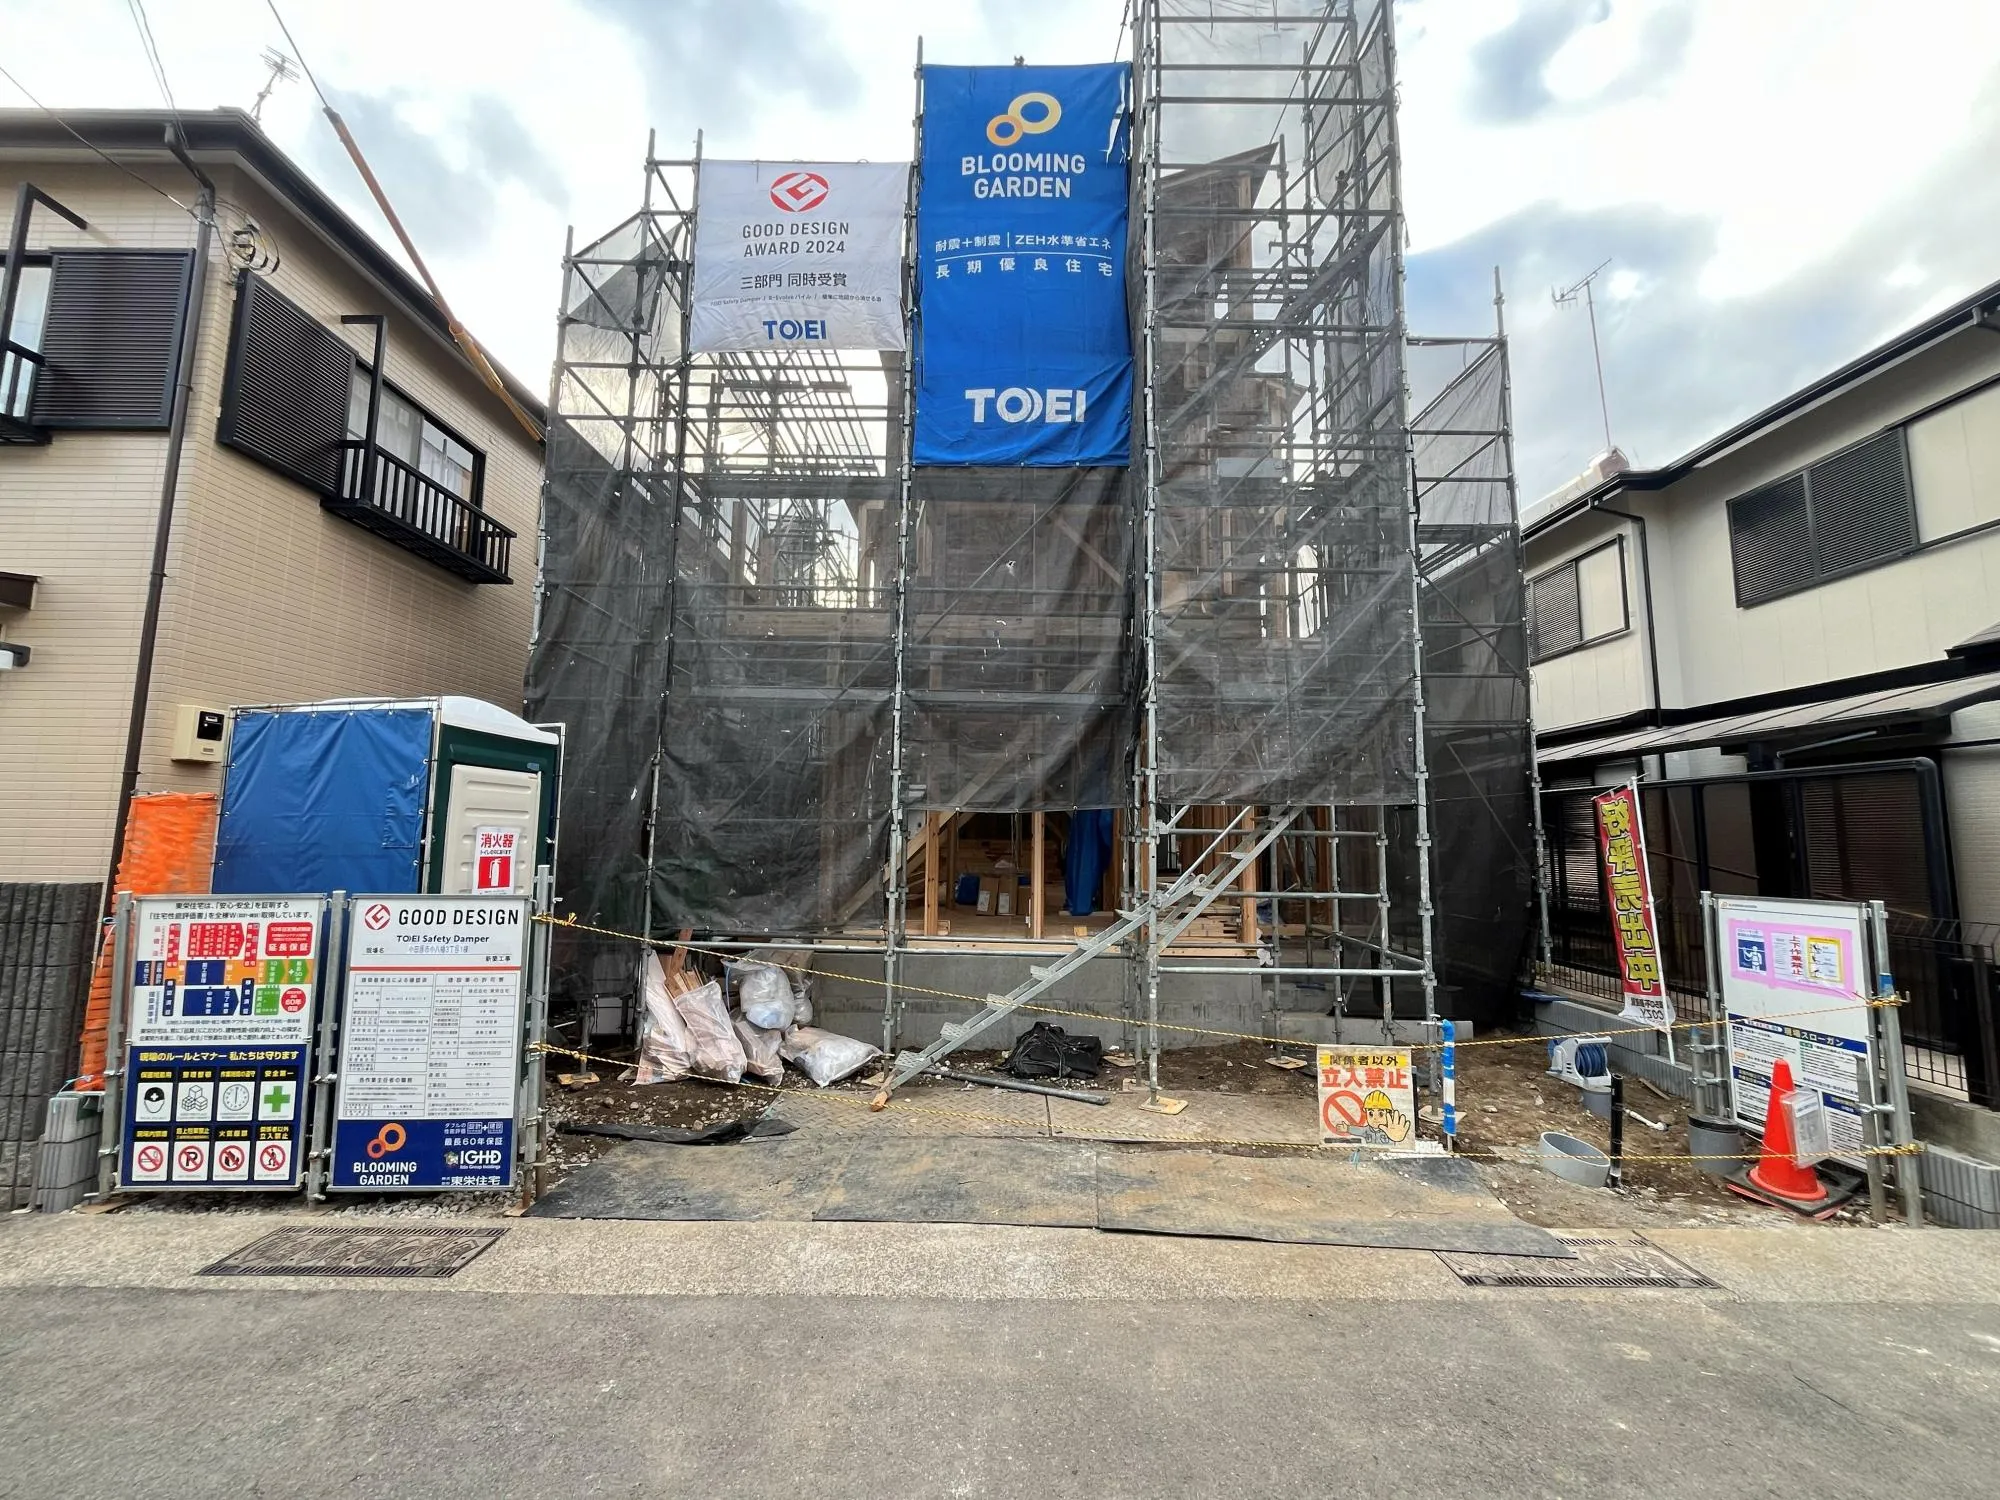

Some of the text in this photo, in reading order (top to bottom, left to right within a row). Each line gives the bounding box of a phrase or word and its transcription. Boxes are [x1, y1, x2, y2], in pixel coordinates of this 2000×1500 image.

[962, 153, 1086, 176] BLOOMING
[974, 176, 1071, 198] GARDEN
[742, 222, 849, 239] GOOD DESIGN
[744, 240, 846, 258] AWARD 2024
[1015, 234, 1112, 250] ZEH水準省エネ
[935, 257, 1113, 280] 長期優良住宅
[740, 272, 848, 290] 三部門 同時受賞
[480, 833, 514, 848] 消火器
[398, 909, 519, 925] GOOD DESIGN
[422, 935, 452, 944] Safety
[454, 935, 489, 944] Damper
[140, 1051, 299, 1062] 現場のルールとマナー 私たちは守ります
[1329, 1055, 1399, 1066] 関係者以外
[1321, 1067, 1408, 1089] 立入禁止
[353, 1161, 417, 1173] BLOOMING
[359, 1174, 409, 1186] GARDEN
